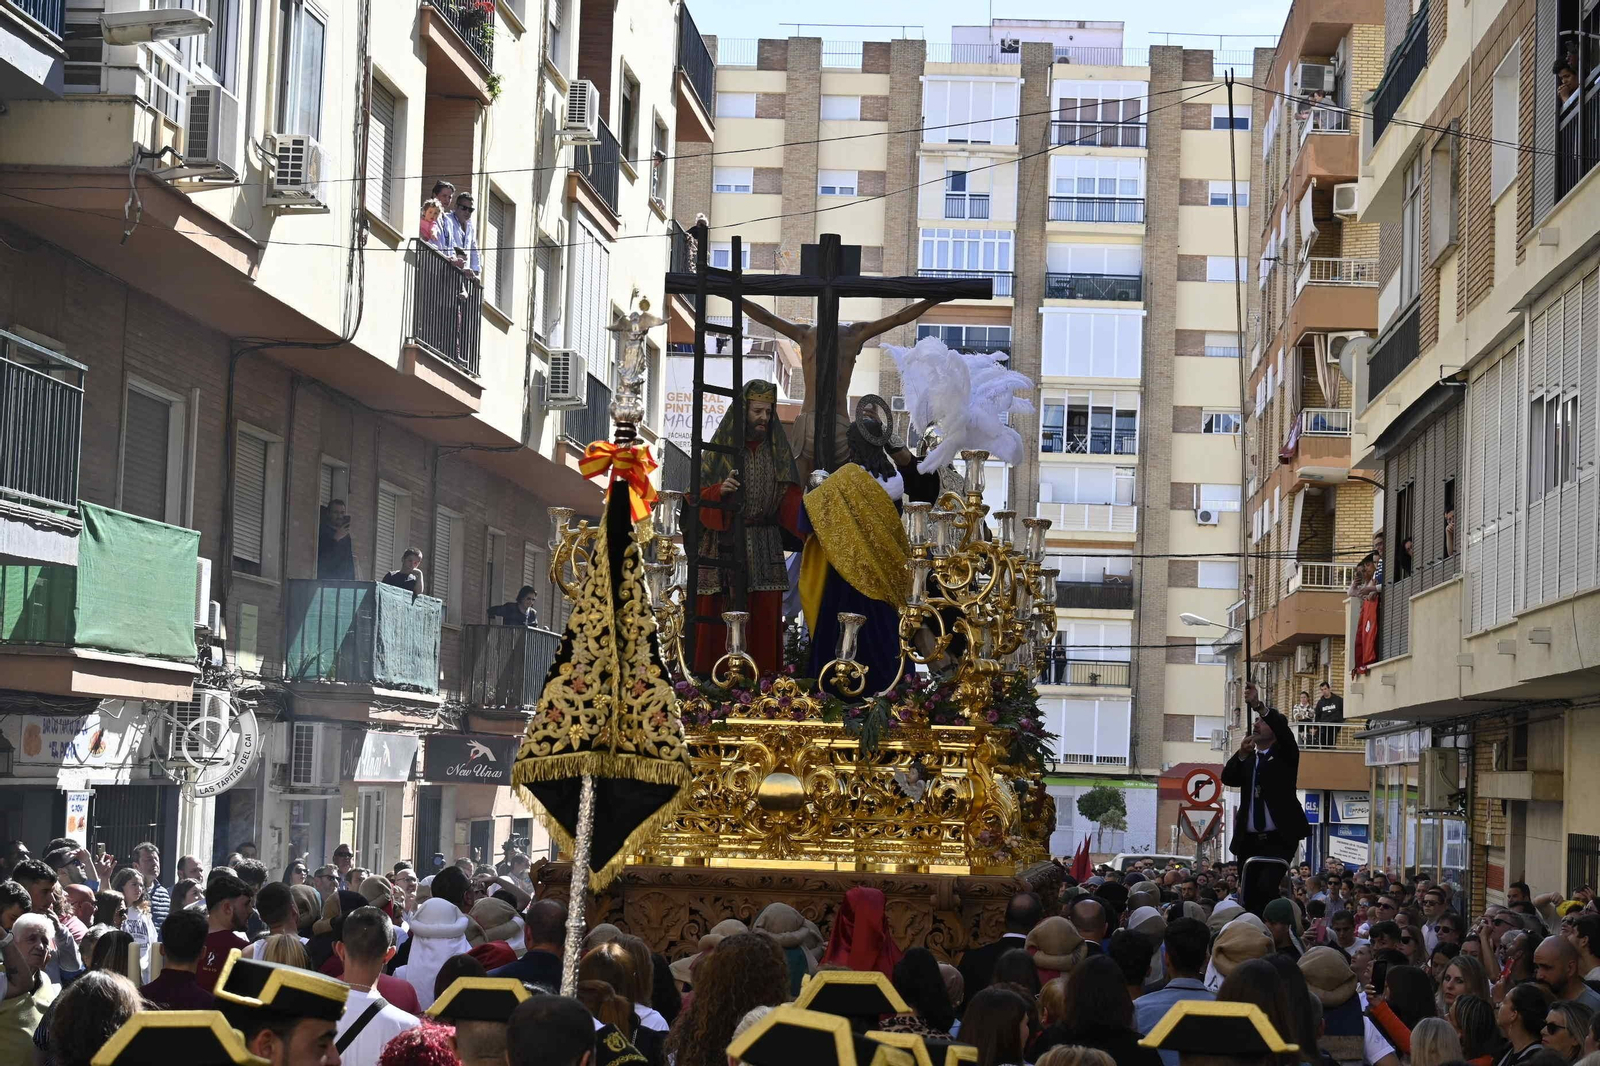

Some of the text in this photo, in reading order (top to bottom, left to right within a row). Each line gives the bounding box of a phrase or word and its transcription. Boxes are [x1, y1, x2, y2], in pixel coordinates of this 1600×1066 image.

[666, 392, 724, 403] GENRAL
[664, 403, 725, 414] PINTRAS
[199, 733, 252, 795] LAS TAPITAS DEL CAI
[446, 763, 503, 778] New Uñas
